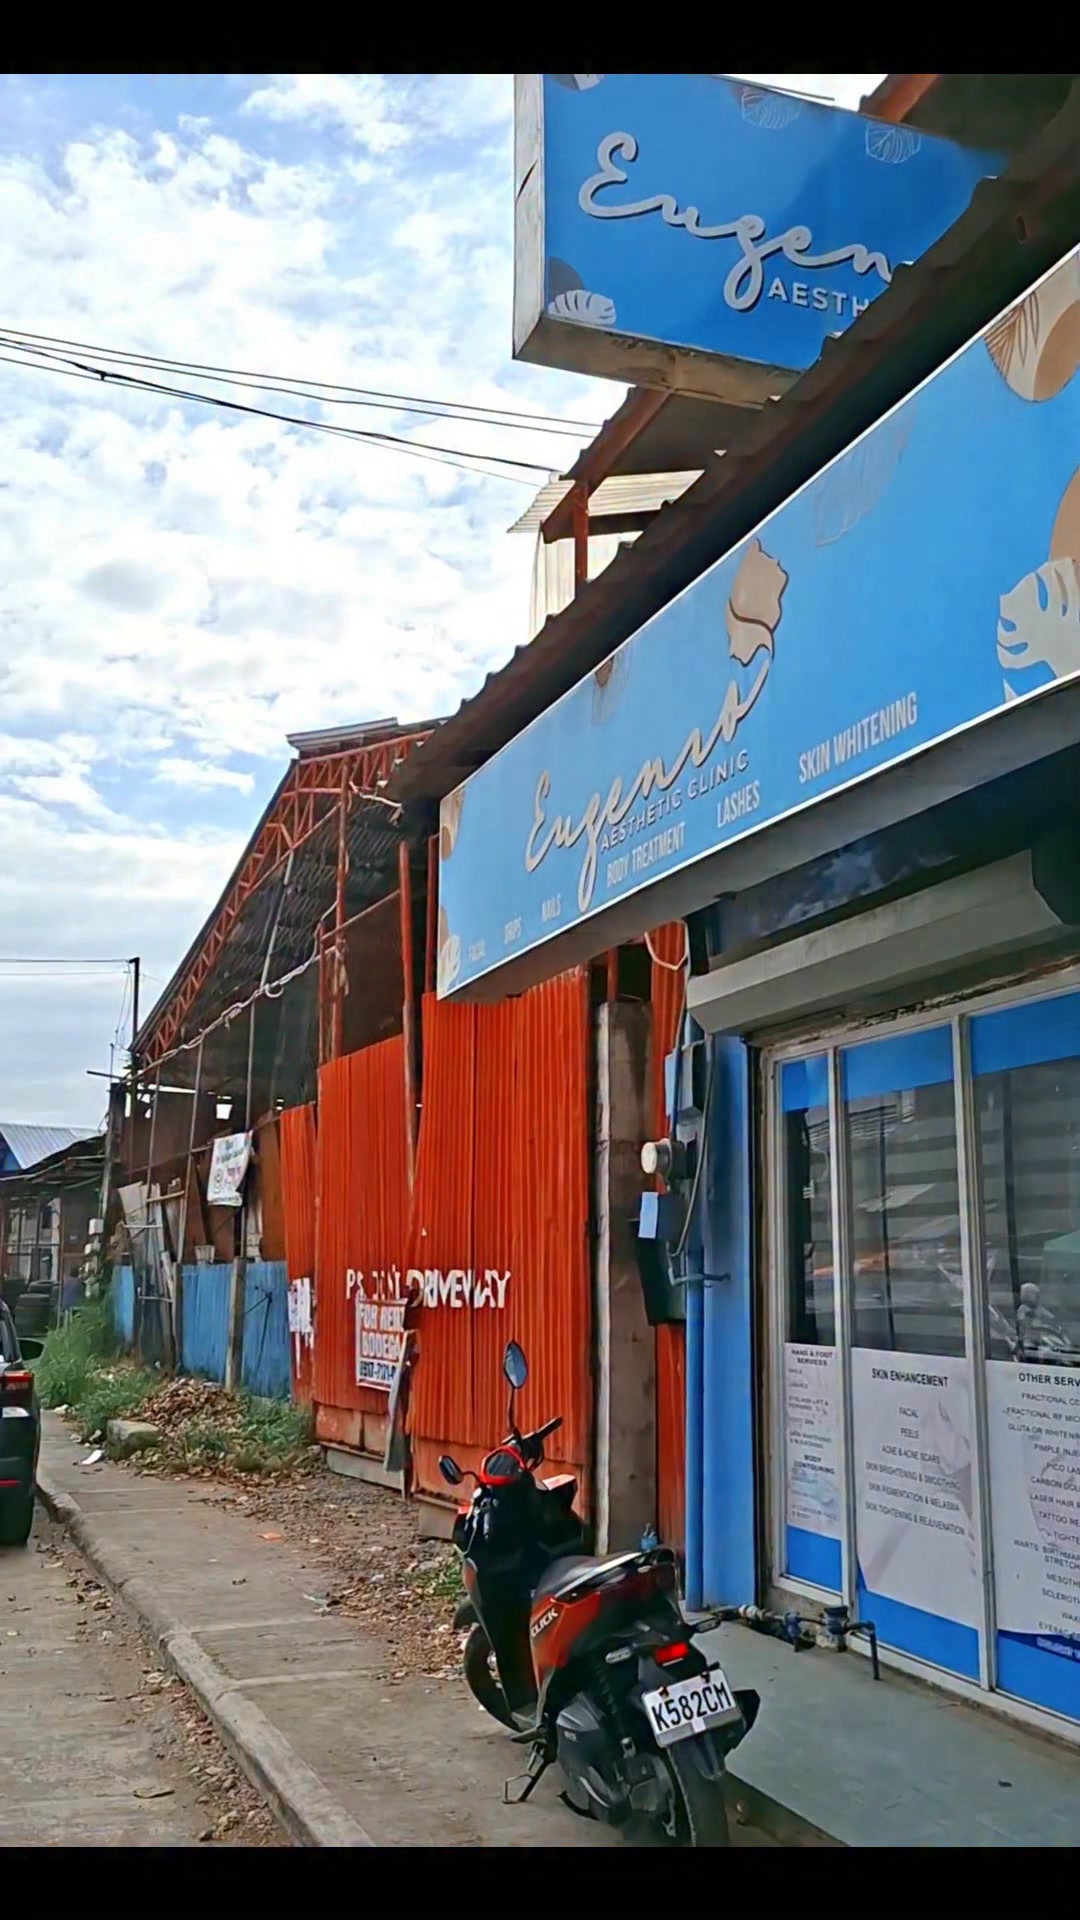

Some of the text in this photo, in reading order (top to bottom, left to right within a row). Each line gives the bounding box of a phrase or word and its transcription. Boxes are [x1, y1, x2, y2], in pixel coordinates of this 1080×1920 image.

[799, 691, 918, 784] SKIN WHITENING
[601, 749, 750, 854] AESTHETIC CLINIC
[717, 779, 761, 829] LASHES
[606, 822, 686, 889] BODY TREATMENT
[872, 1367, 949, 1388] SKIN ENHANCEMENT
[1018, 1372, 1051, 1385] OTHER
[1021, 1392, 1068, 1406] FRACTIONAL
[898, 1406, 919, 1419] FACIAL
[1006, 1406, 1051, 1420] FRACTIONAL
[1030, 1475, 1062, 1489] CARBON
[1039, 1510, 1068, 1525] TATTOO
[531, 1607, 559, 1638] CLICK
[651, 1681, 732, 1732] K582CM
